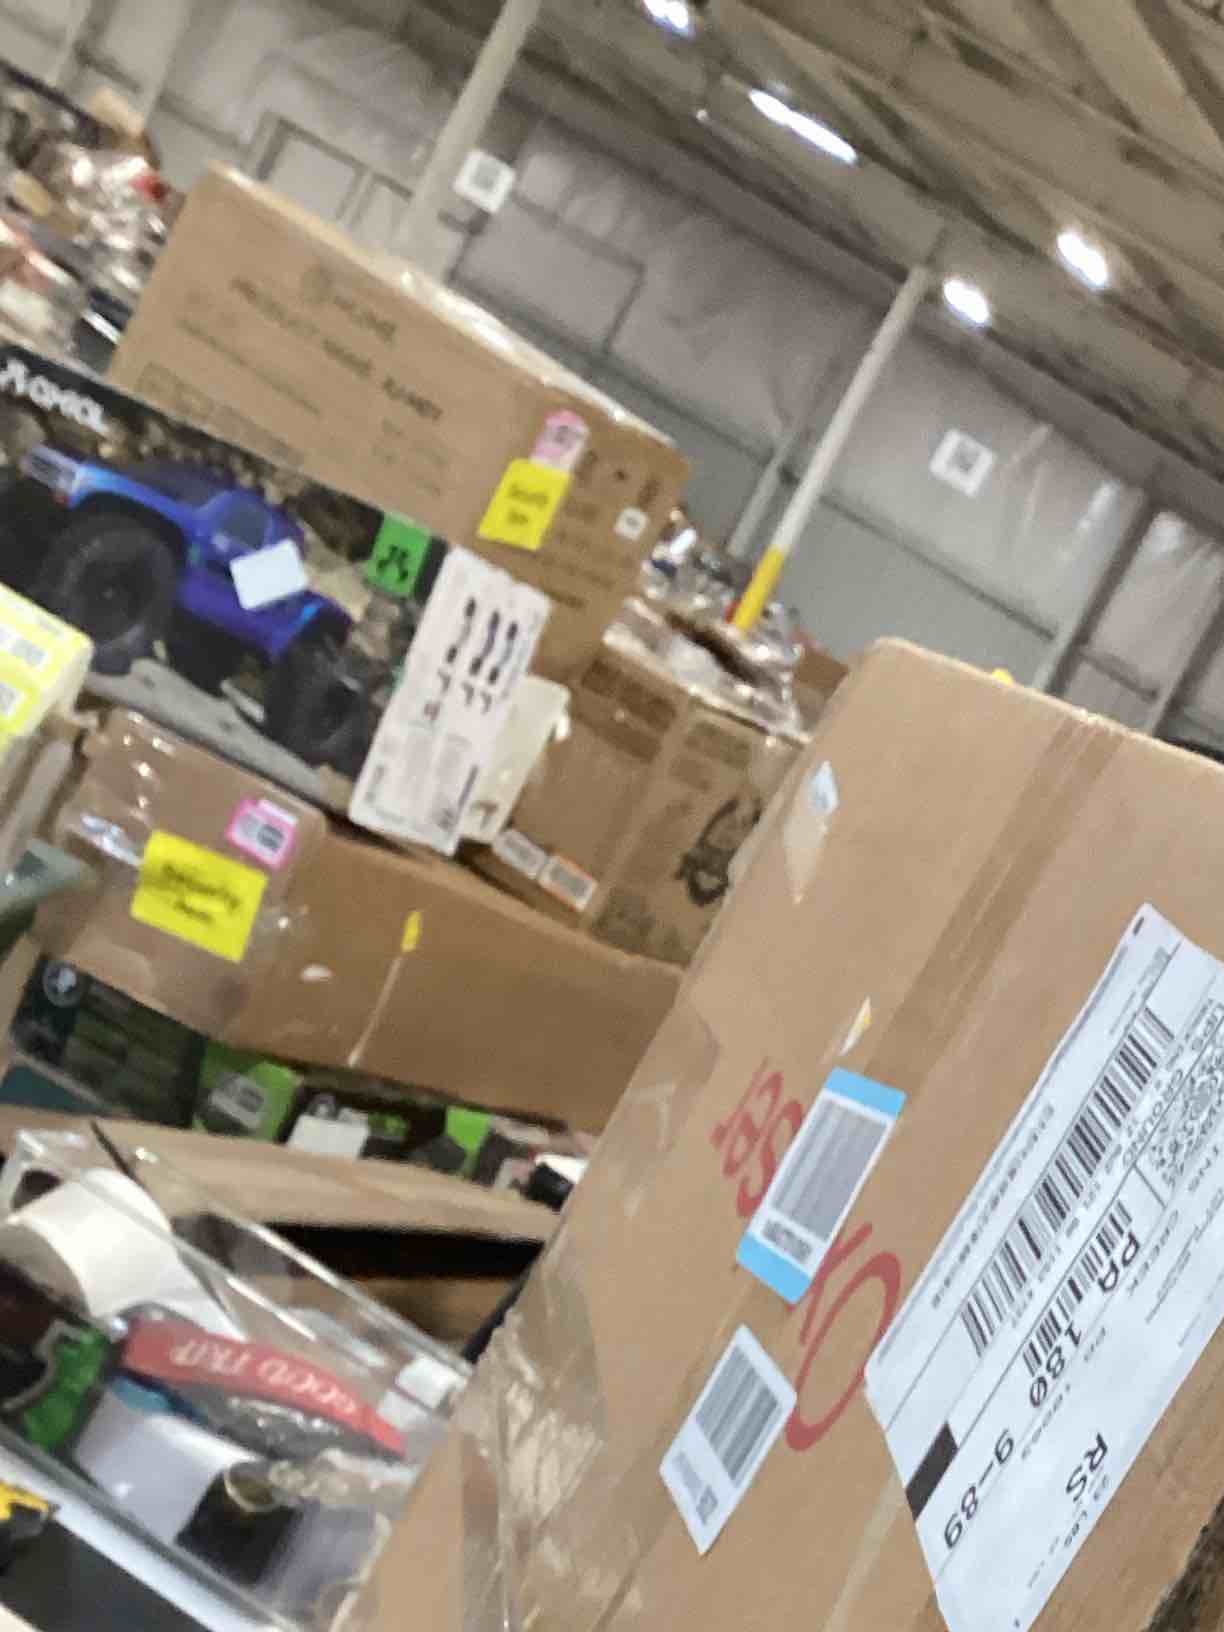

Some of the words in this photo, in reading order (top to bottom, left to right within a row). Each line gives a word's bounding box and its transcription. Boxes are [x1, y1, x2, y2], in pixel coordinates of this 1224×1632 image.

[1119, 1065, 1185, 1171] GROUND
[1096, 1229, 1141, 1301] PA
[1122, 1206, 1182, 1302] CREEK
[1025, 1315, 1085, 1415] 180
[940, 1423, 1017, 1555] 9-89
[1063, 1429, 1110, 1508] RS
